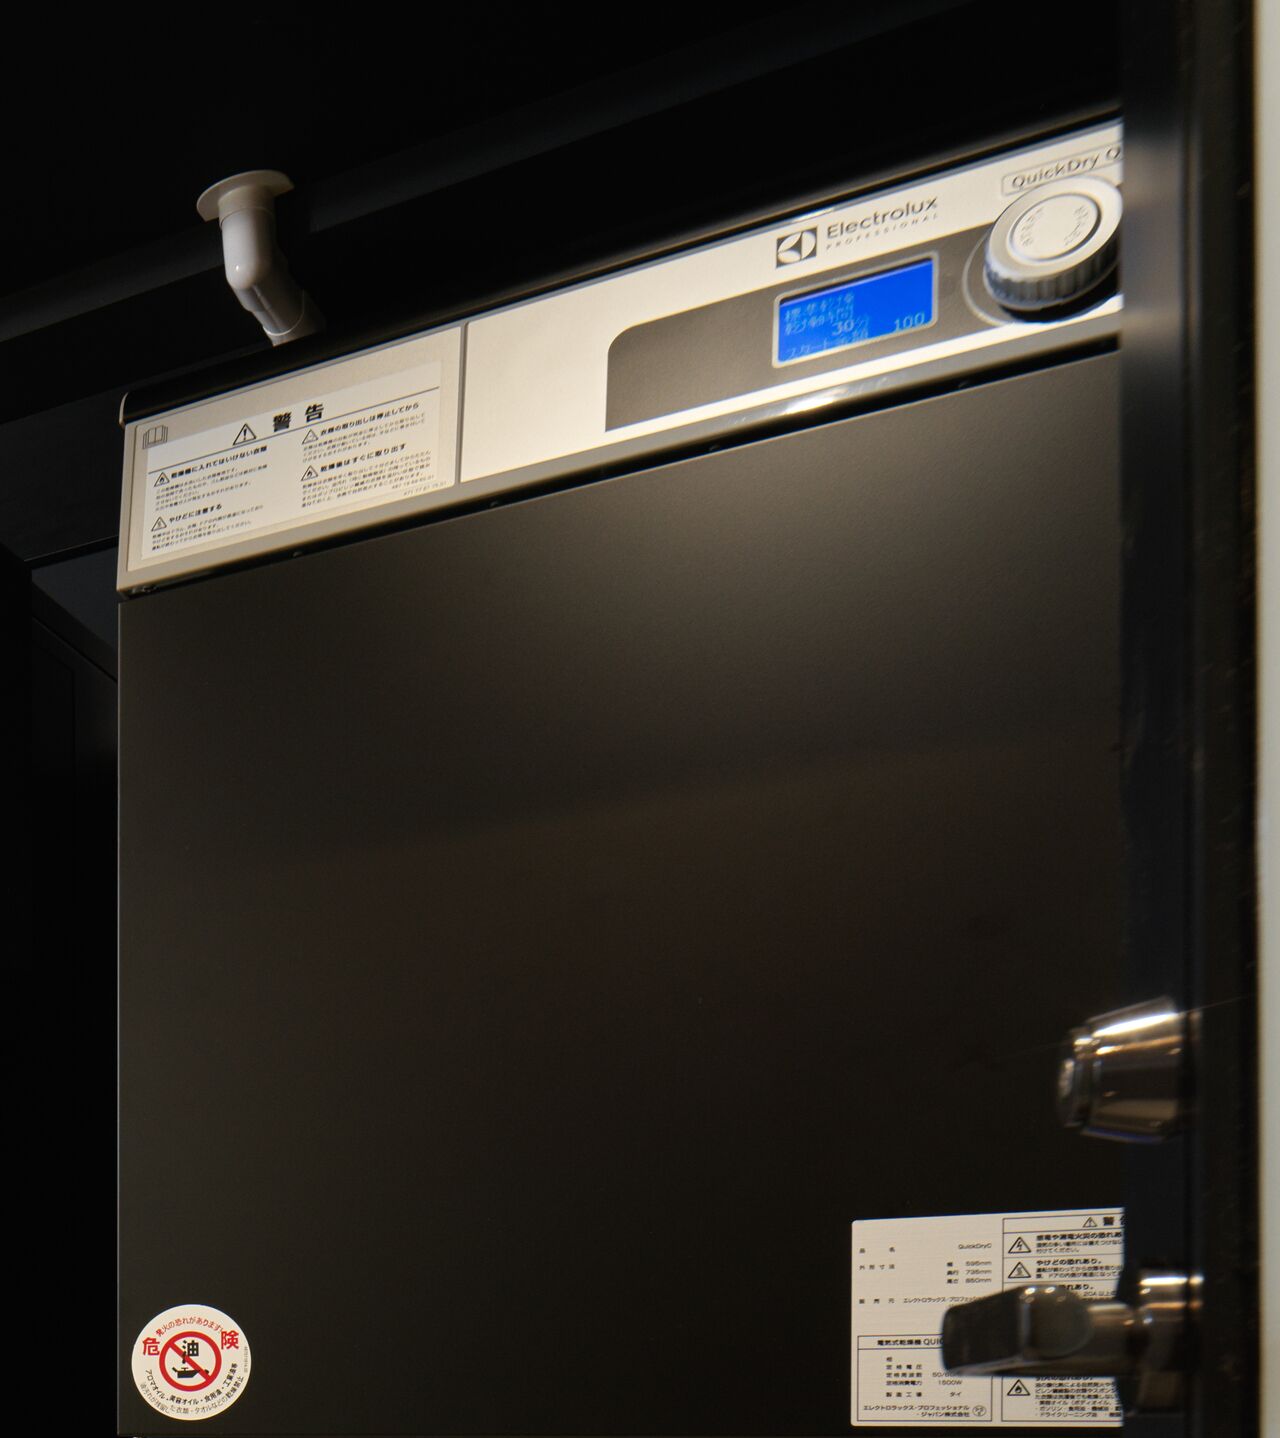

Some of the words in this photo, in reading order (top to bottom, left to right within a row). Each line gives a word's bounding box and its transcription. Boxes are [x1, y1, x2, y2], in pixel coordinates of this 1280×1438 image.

[1011, 153, 1100, 190] QuickDry
[826, 196, 938, 239] Electrolux
[826, 213, 938, 250] PROFESSIONAL
[893, 312, 926, 333] 100
[182, 1339, 199, 1364] 油
